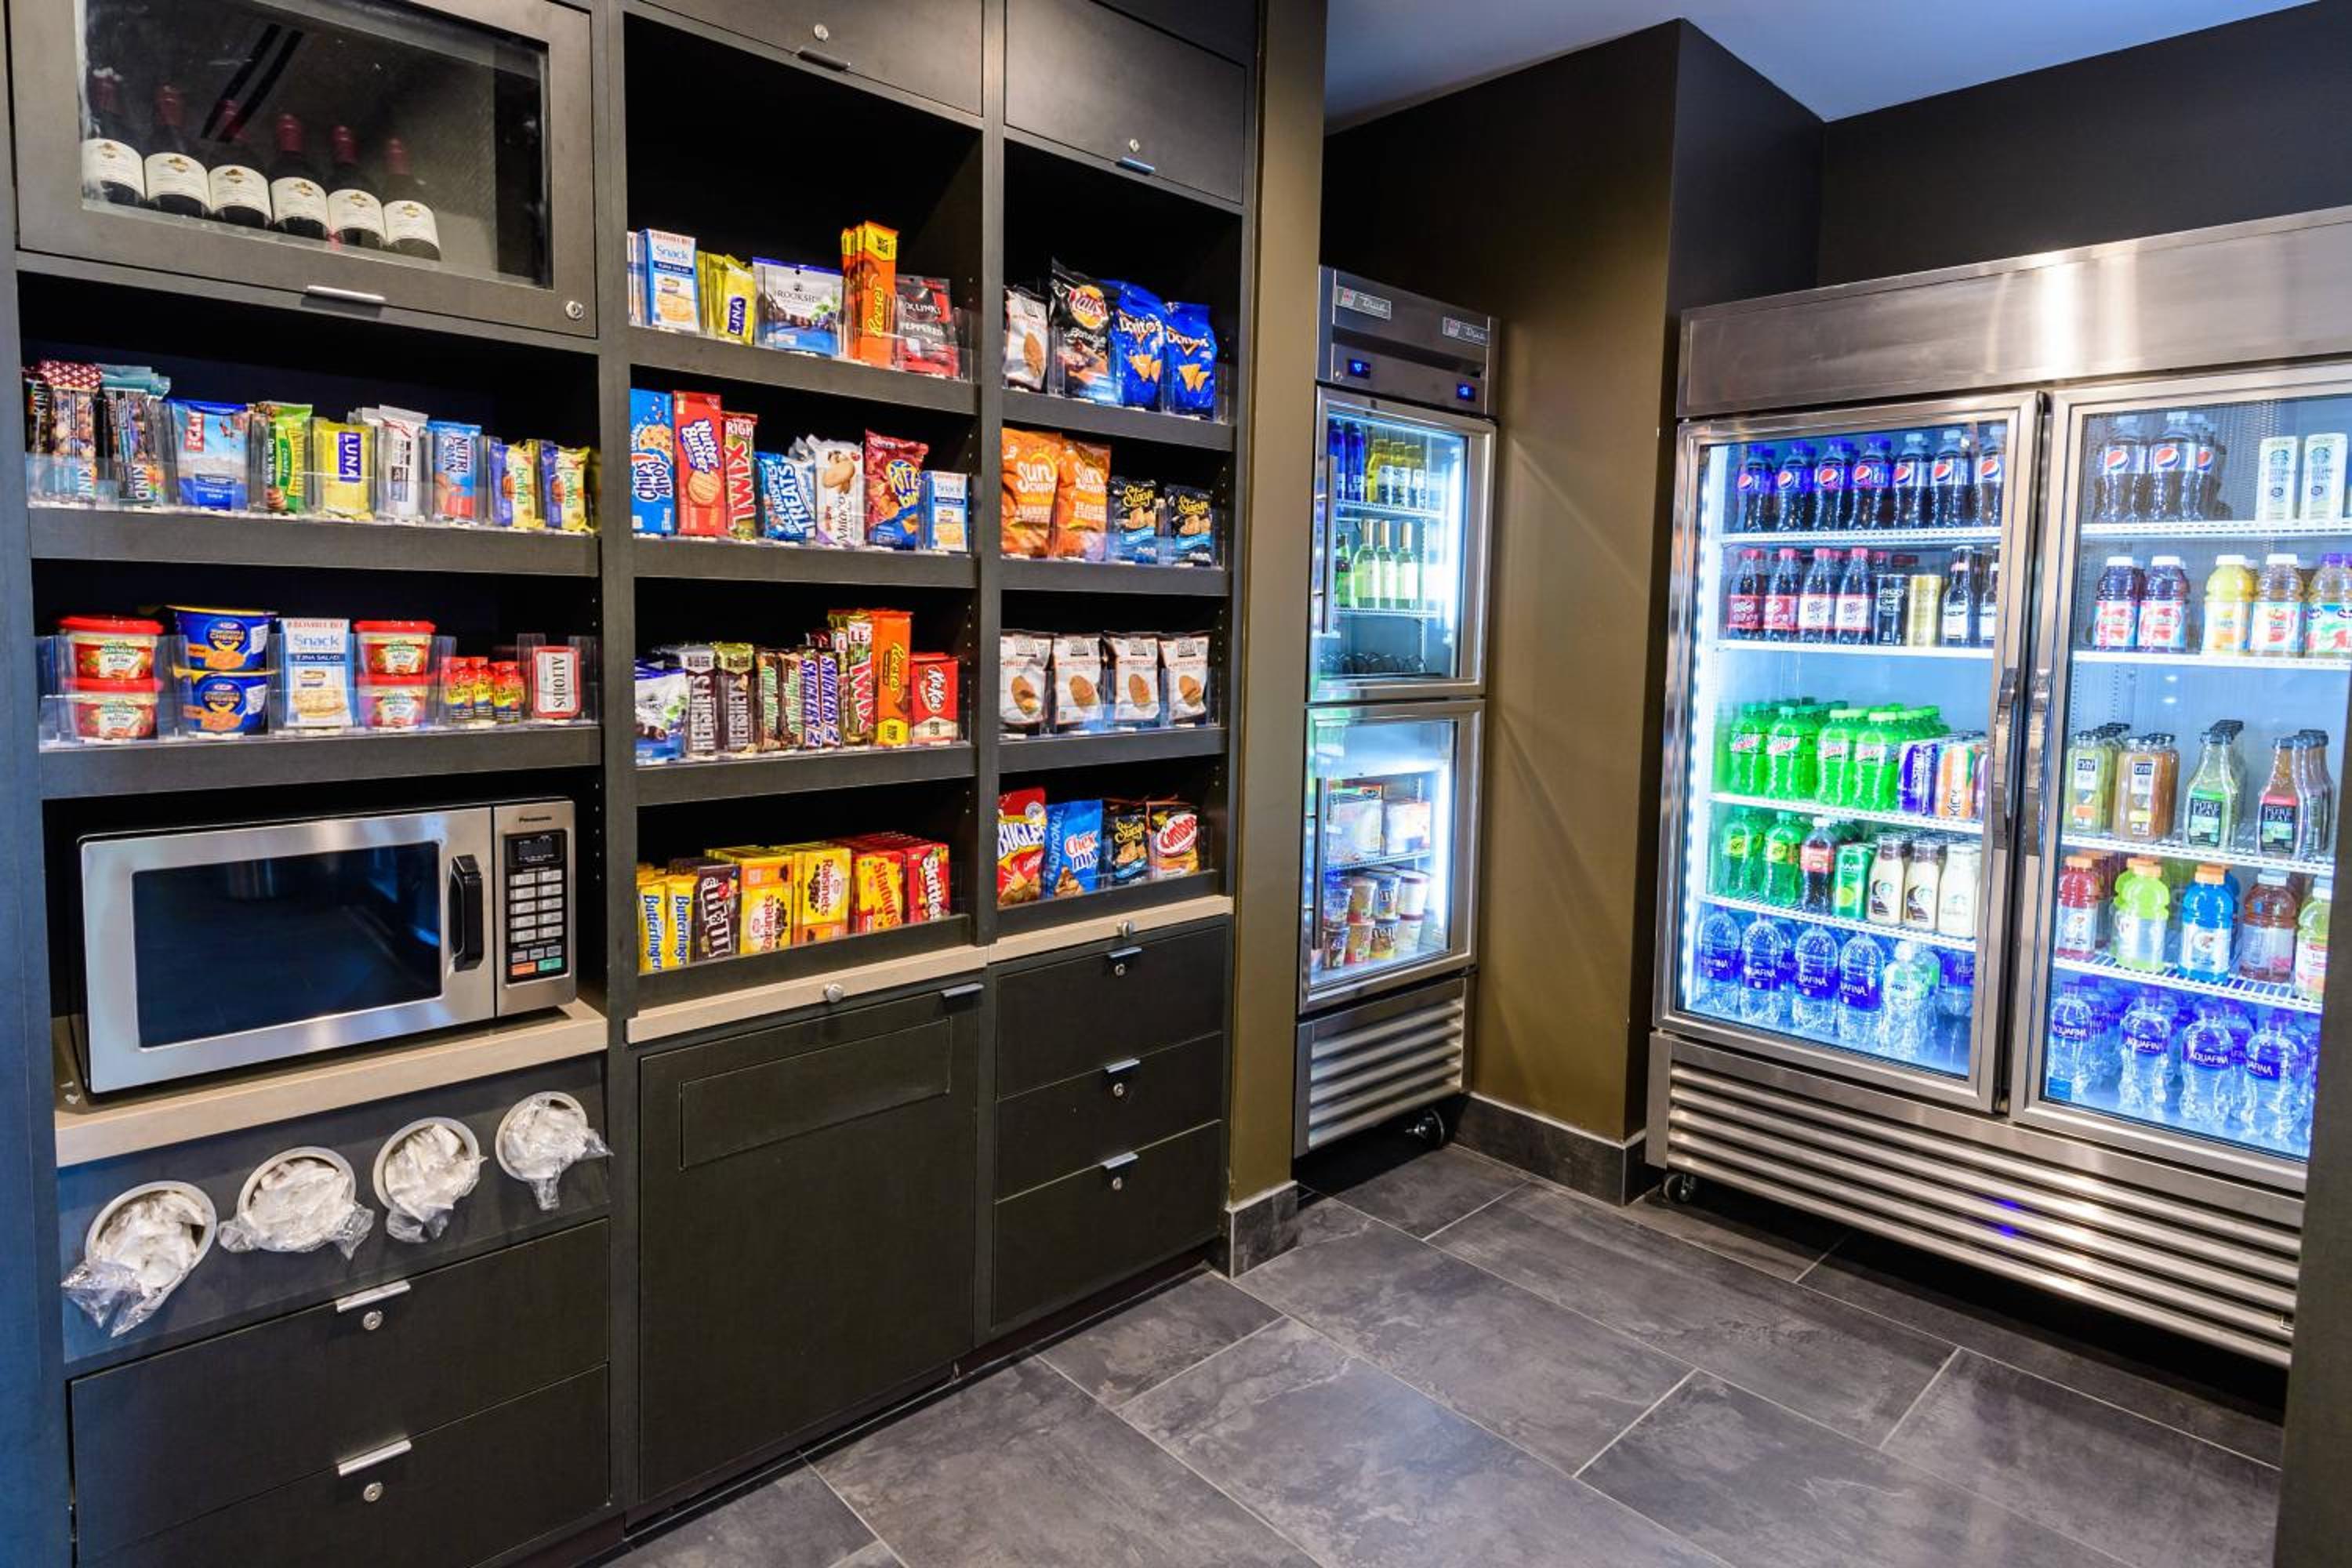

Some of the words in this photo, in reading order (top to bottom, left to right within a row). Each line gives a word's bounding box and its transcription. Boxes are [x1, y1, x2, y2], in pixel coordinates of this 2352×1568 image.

[655, 245, 689, 260] Snack
[730, 300, 742, 334] LUNA
[1118, 315, 1163, 333] Doritos
[681, 426, 710, 474] Butter
[694, 419, 720, 468] Nutter
[726, 421, 753, 437] RIGH
[343, 434, 358, 477] LUNA
[455, 437, 468, 474] NUTRI
[1017, 461, 1055, 493] Sun
[132, 463, 149, 500] KIND
[637, 463, 658, 501] Chips
[724, 441, 756, 529] TWIX
[778, 464, 815, 532] TREATS
[293, 634, 339, 647] Snack
[551, 655, 566, 708] ALTOIDS
[800, 659, 821, 728] SNICKERS
[821, 658, 838, 724] SNICKERS
[850, 660, 873, 733] TWIX
[690, 675, 716, 751] HERSHEY'S
[2193, 801, 2220, 811] PURE
[1065, 831, 1098, 858] Chex
[820, 858, 833, 916] Raisinets
[873, 862, 902, 926] Starburs
[644, 895, 662, 971] Butterfinger
[674, 896, 691, 966] Butterfinge
[2189, 1050, 2229, 1065] AQUAFINA
